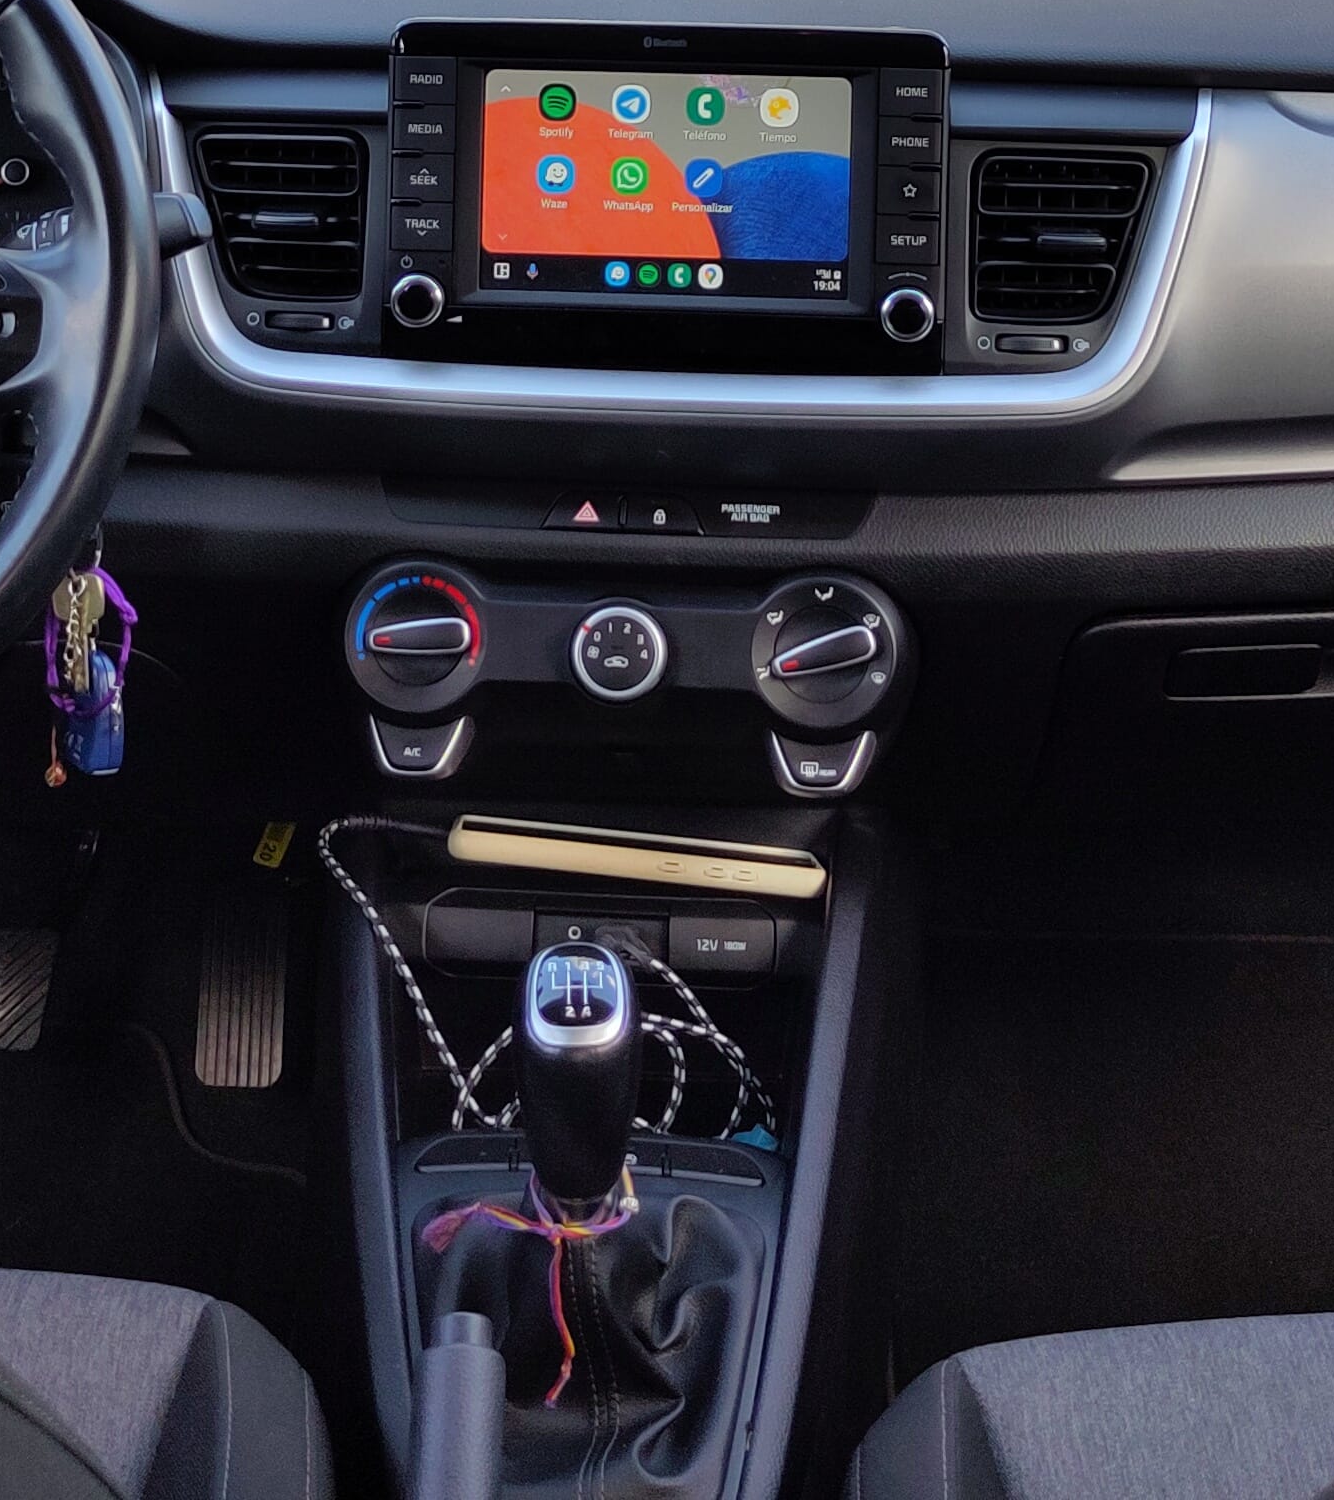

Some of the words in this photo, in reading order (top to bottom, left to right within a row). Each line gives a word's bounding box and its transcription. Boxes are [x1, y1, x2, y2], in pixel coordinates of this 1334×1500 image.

[409, 74, 444, 85] RADIO
[895, 86, 929, 97] HOME
[407, 123, 443, 134] MEDIA
[538, 126, 574, 140] Spotify
[608, 128, 654, 140] Telegram
[682, 129, 727, 141] Teléfono
[759, 131, 797, 144] Tiempo
[891, 136, 930, 148] PHONE
[409, 174, 439, 186] SEEK
[540, 197, 568, 209] Waze
[603, 199, 654, 213] WhatsApp
[671, 201, 734, 214] Personalizar
[404, 218, 440, 229] TRACK
[890, 234, 927, 246] SETUP
[813, 280, 841, 291] 19:04
[720, 503, 781, 515] PASSENGER
[730, 512, 747, 522] AIR
[623, 622, 632, 635] 2
[639, 648, 648, 660] 4
[403, 746, 422, 757] A/C
[696, 938, 719, 952] 12V
[565, 1005, 577, 1018] 2
